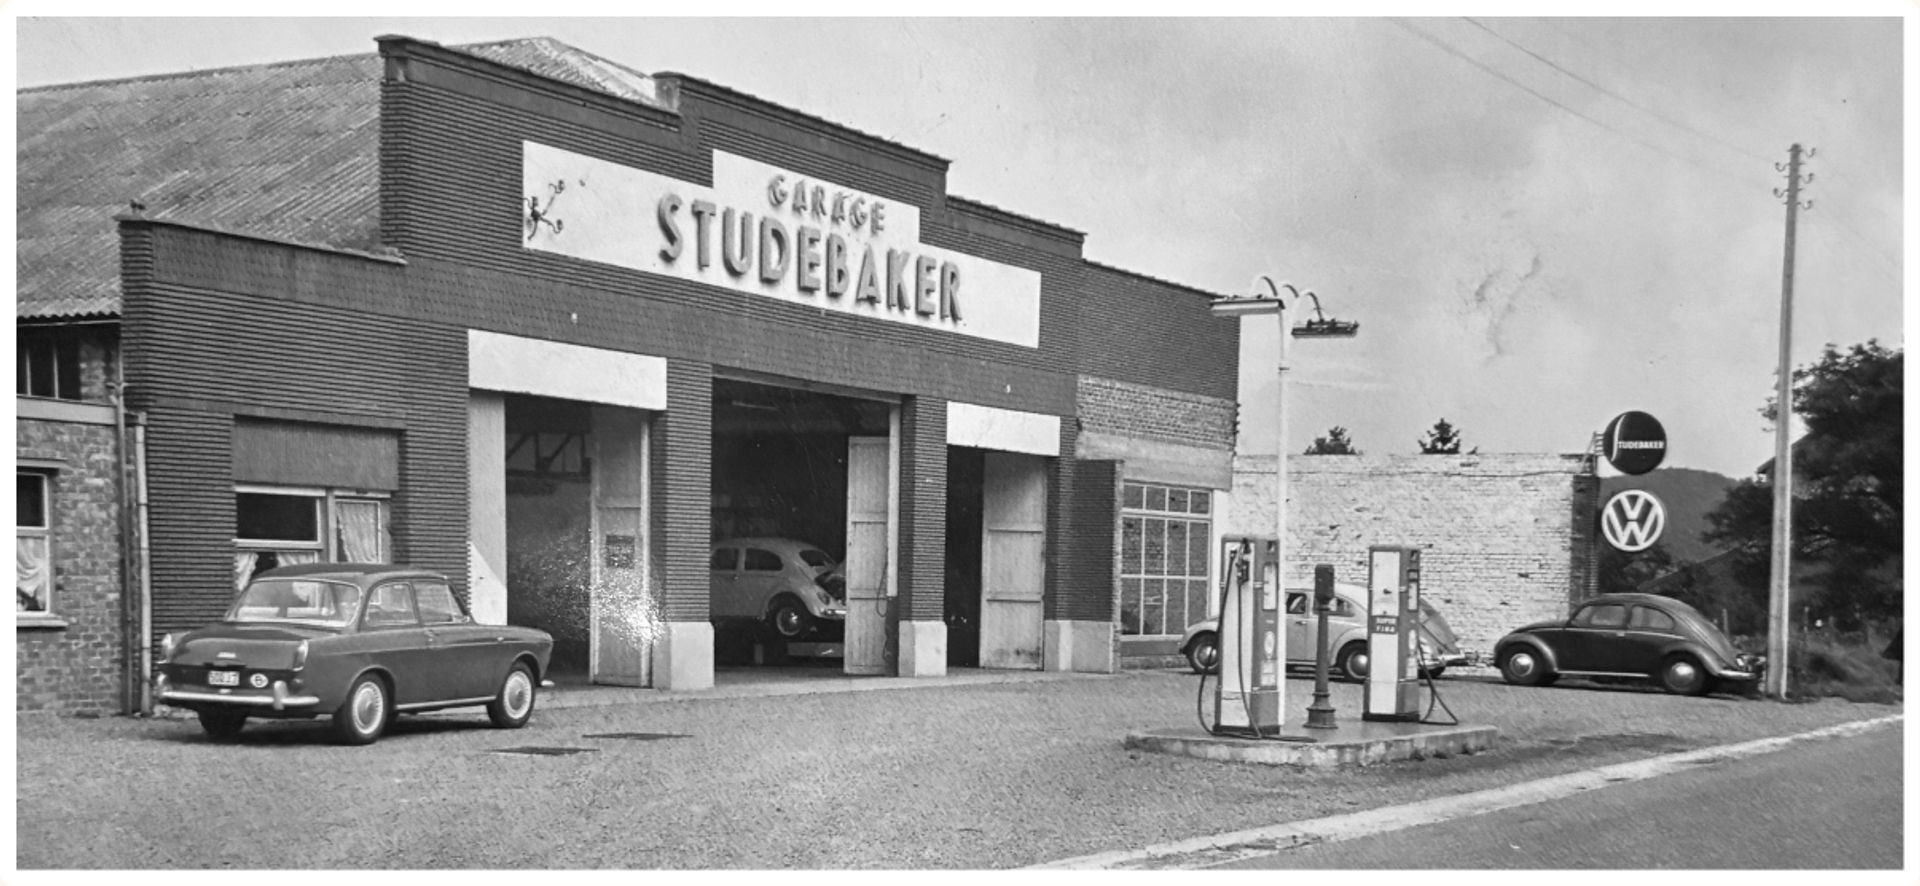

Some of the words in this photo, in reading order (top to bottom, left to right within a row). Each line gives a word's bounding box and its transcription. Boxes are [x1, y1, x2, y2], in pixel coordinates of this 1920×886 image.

[767, 174, 885, 237] GARAGE
[657, 193, 963, 322] STUDEBAKER
[1610, 414, 1664, 462] STUDEBAKER
[1601, 489, 1665, 552] VW
